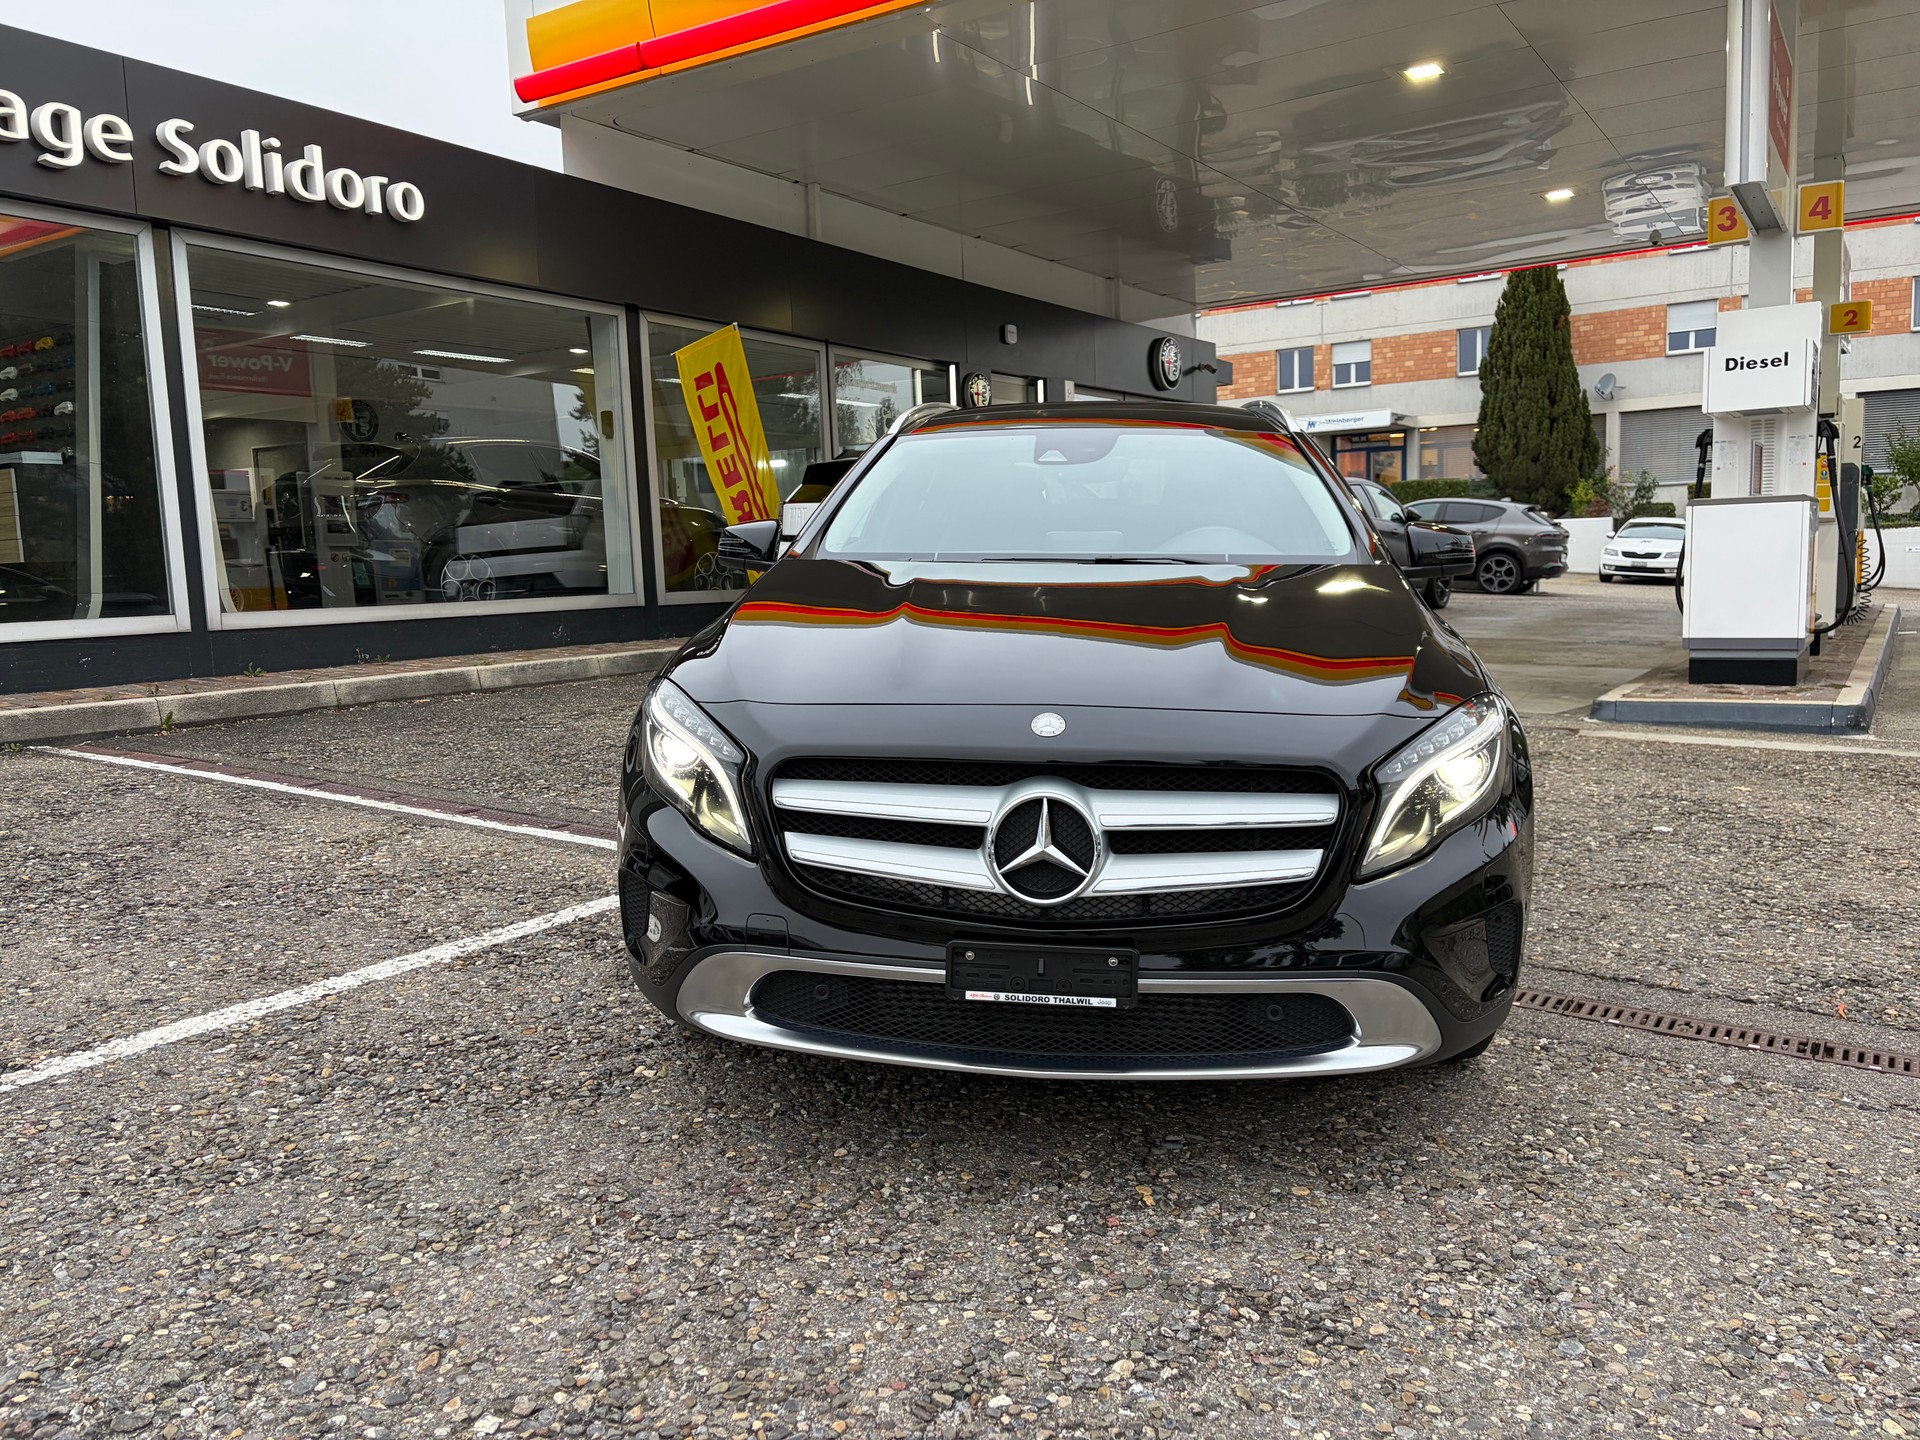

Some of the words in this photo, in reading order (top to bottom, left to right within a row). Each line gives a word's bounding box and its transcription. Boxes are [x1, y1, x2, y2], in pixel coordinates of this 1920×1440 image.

[155, 118, 425, 223] Solidoro
[1808, 195, 1832, 220] 4
[1717, 206, 1738, 232] 3
[1843, 310, 1858, 327] 2
[1724, 351, 1789, 372] Diesel
[1853, 435, 1862, 449] 2
[1004, 993, 1050, 1004] SOLIDORO
[1052, 996, 1093, 1005] THALWIL
